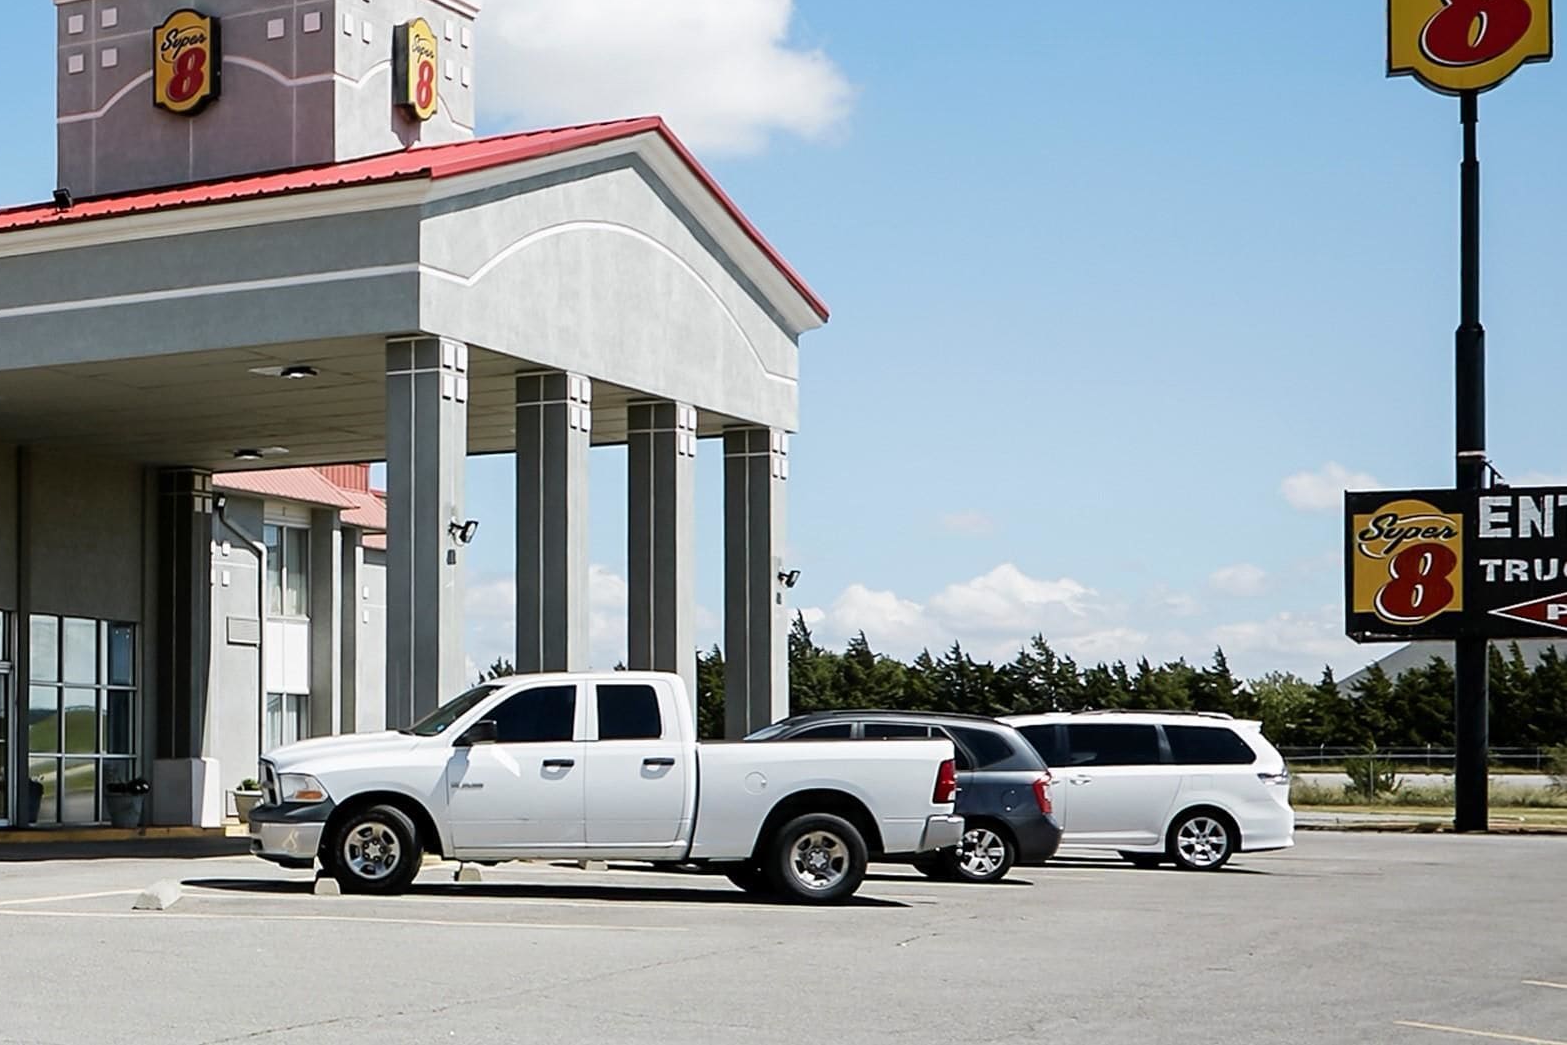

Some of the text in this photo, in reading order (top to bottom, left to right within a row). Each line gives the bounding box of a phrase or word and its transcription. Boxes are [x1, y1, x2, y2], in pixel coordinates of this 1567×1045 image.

[161, 28, 206, 61] Super
[165, 46, 207, 103] 8
[416, 60, 434, 109] 8
[1358, 512, 1459, 556] Super
[1373, 542, 1458, 623] 8
[1478, 558, 1567, 582] TRU
